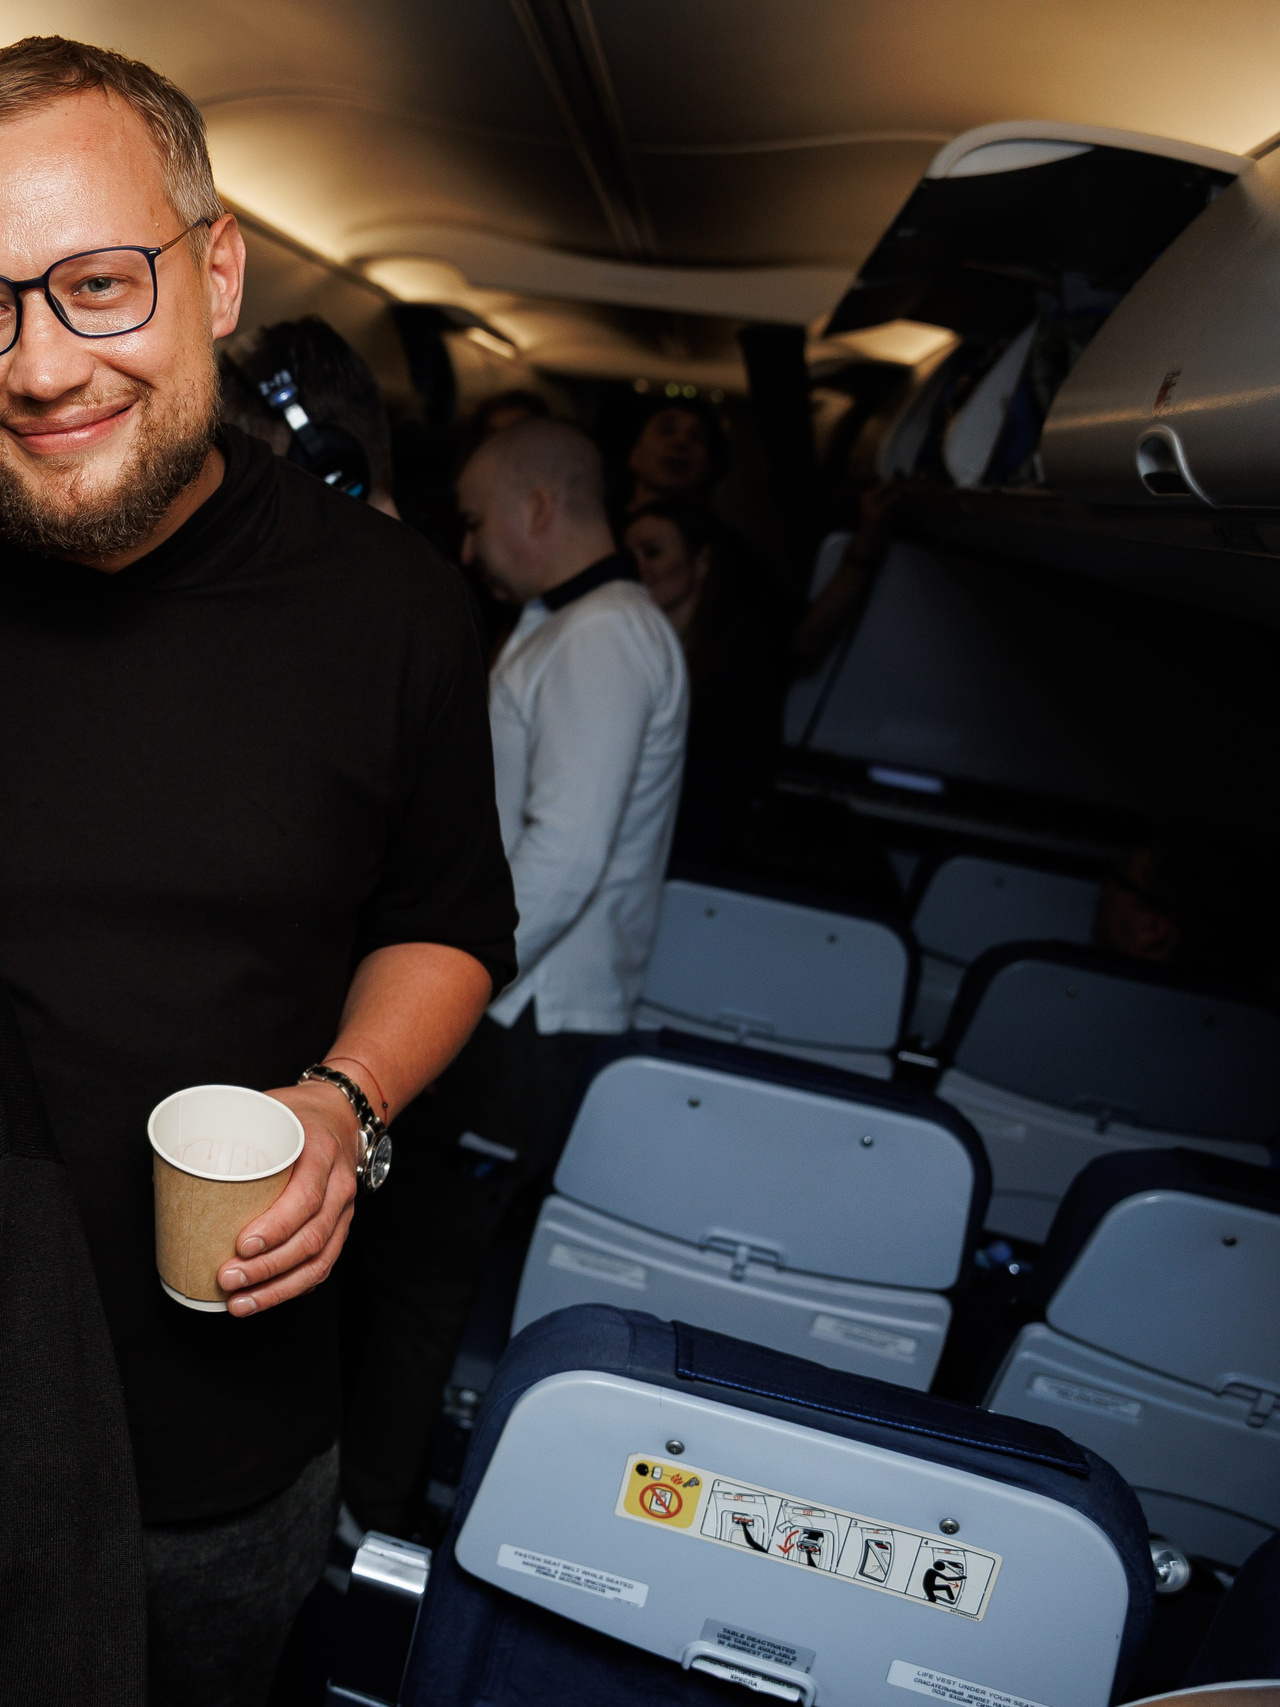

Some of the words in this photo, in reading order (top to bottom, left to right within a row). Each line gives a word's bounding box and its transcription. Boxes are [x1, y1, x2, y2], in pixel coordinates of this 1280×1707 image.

[514, 1550, 541, 1562] FASTEN
[543, 1558, 561, 1567] SEAT
[562, 1563, 580, 1573] BELT
[581, 1569, 604, 1581] WHILE
[606, 1576, 634, 1590] SEATED
[717, 1632, 732, 1641] USE
[734, 1637, 757, 1649] TABLE
[758, 1645, 797, 1662] AVAILABLE
[723, 1627, 745, 1639] TABLE
[747, 1635, 796, 1655] DEACTIVATED
[727, 1642, 762, 1657] ARMREST
[774, 1656, 793, 1667] SEAT
[730, 1673, 758, 1688] КРЕСЛА
[913, 1677, 964, 1697] СПАСАТЕЛЬНЫЙ
[967, 1693, 990, 1704] ЖИЛЕТ
[917, 1670, 934, 1680] LIFE
[936, 1675, 957, 1686] VEST
[958, 1682, 986, 1696] UNDER
[988, 1691, 1012, 1704] YOUR
[931, 1687, 946, 1697] ПОД
[948, 1693, 973, 1705] ВАШИМ
